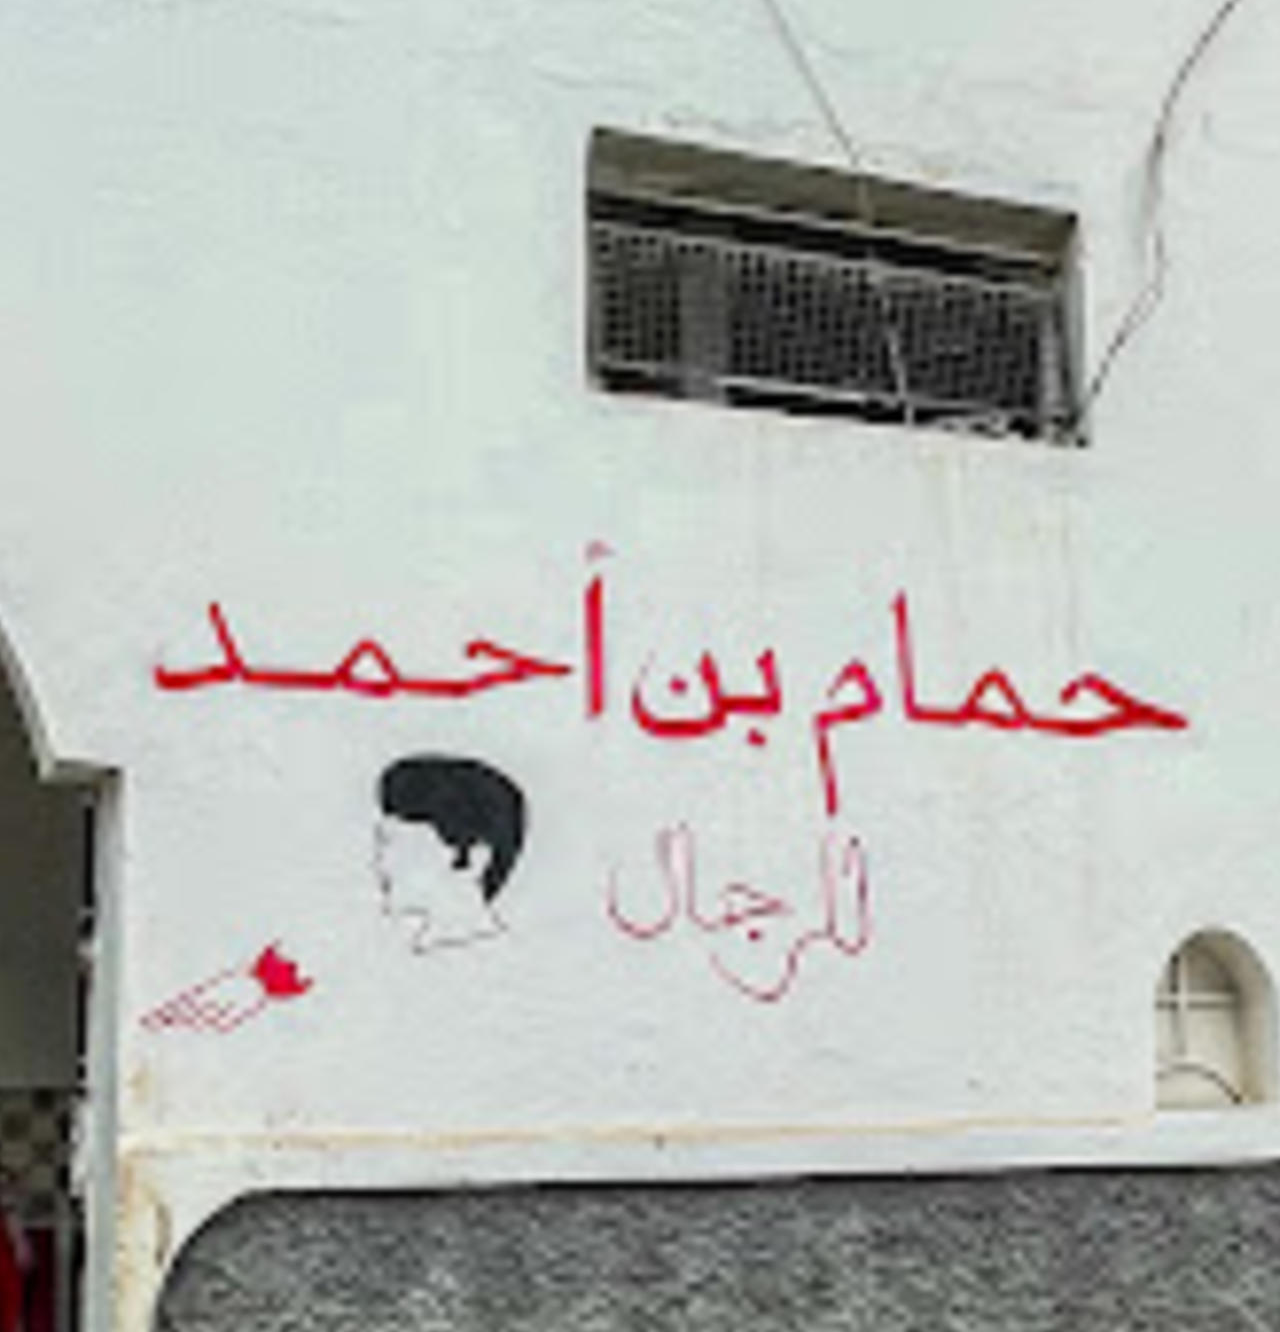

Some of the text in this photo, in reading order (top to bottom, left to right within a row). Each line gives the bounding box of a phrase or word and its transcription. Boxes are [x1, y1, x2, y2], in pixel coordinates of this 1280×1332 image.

[150, 541, 1193, 819] حمام بن أحمد
[606, 823, 873, 1003] للرجال
